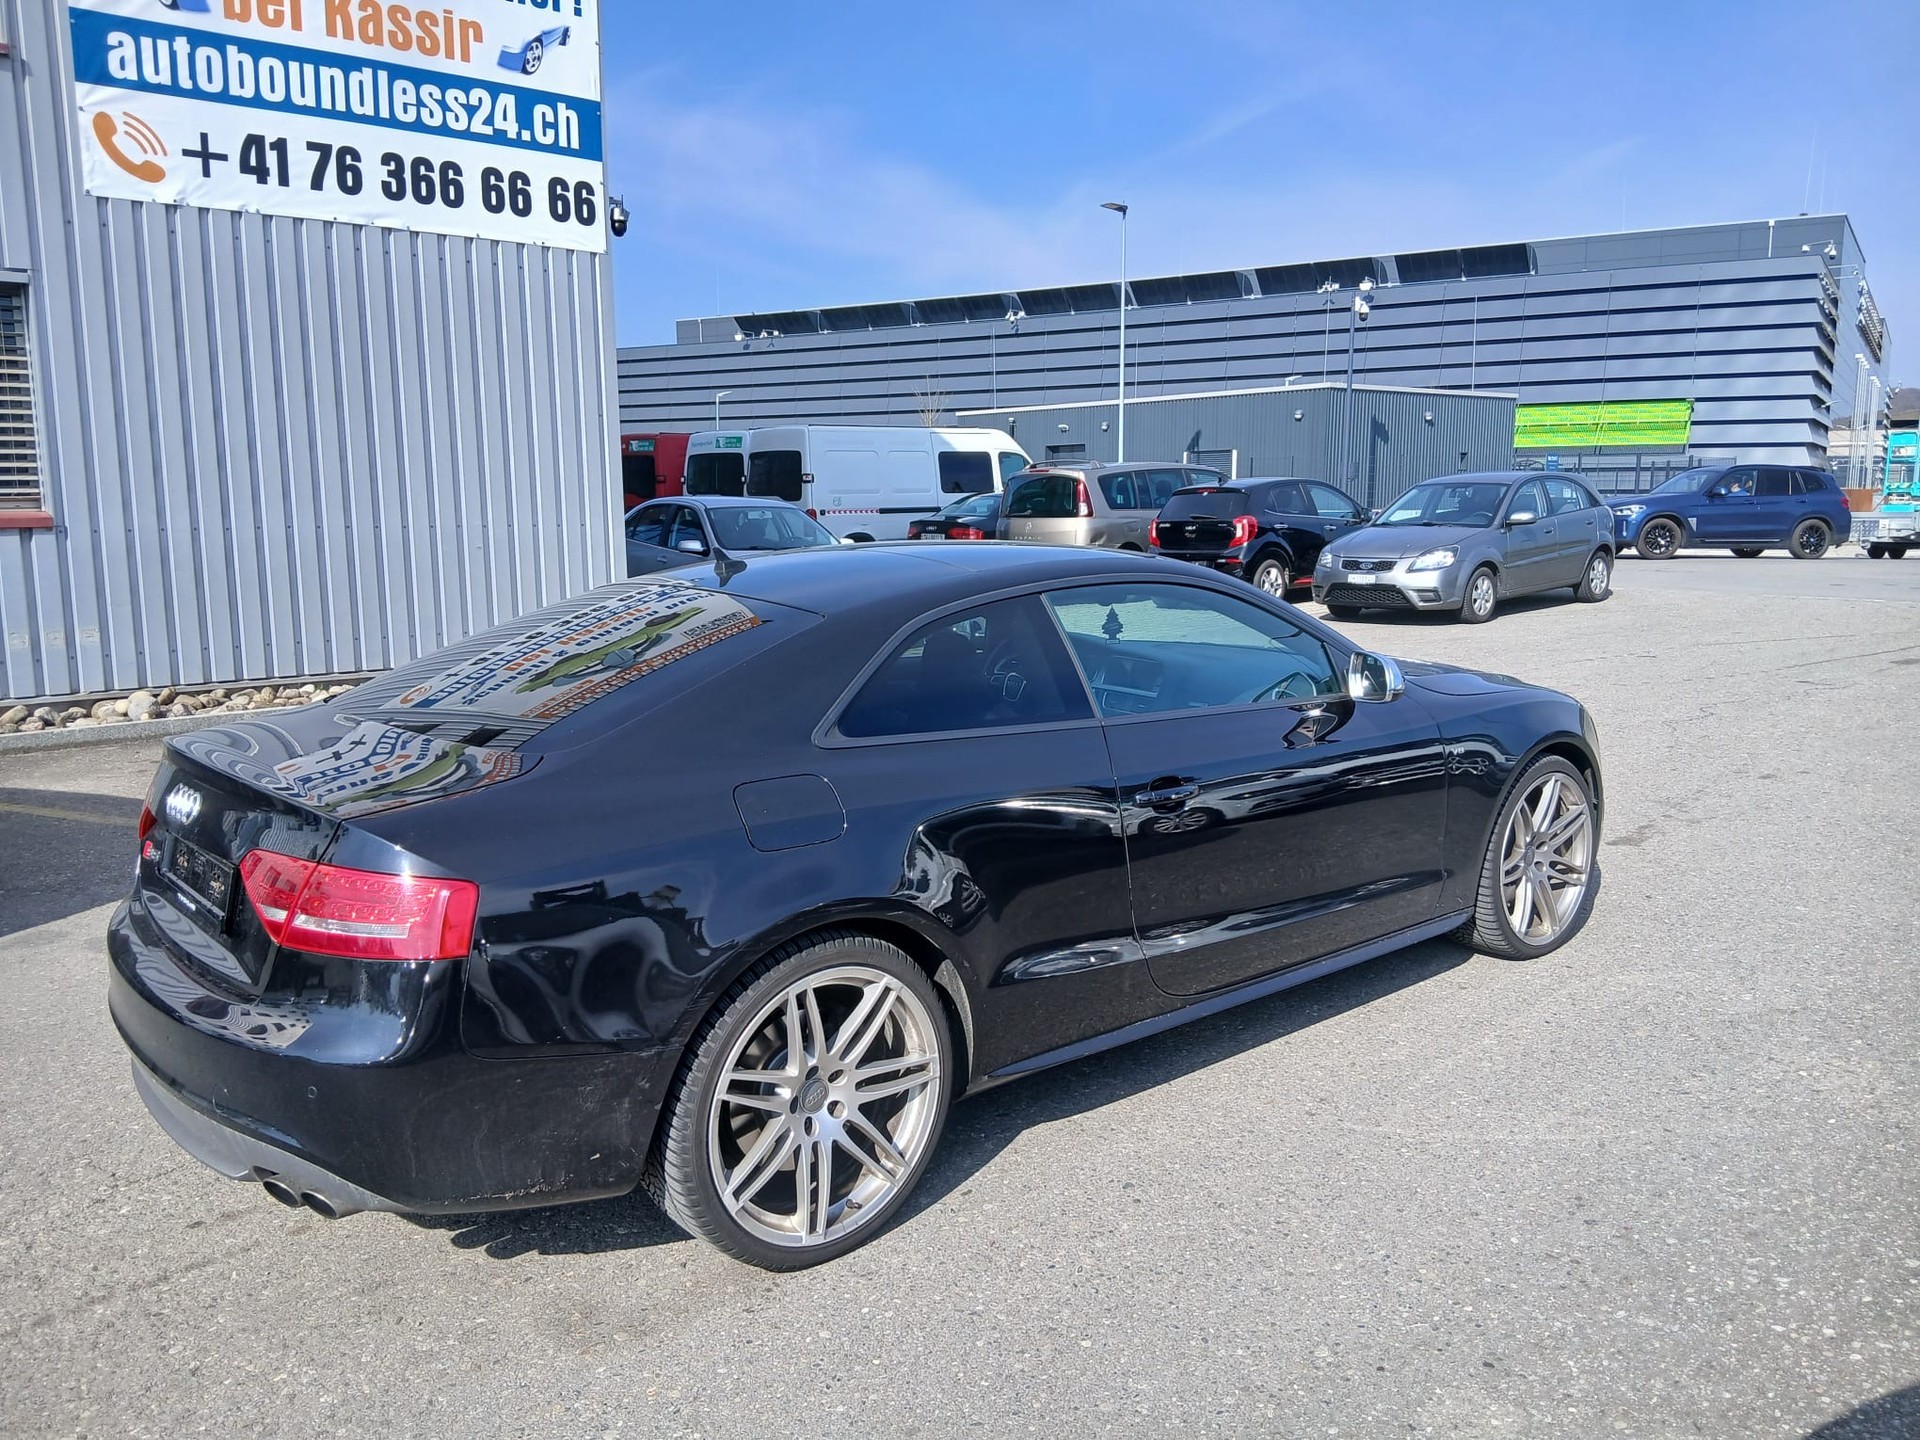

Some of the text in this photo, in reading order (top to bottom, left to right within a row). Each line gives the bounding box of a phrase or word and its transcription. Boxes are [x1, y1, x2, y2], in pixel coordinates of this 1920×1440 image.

[325, 0, 483, 63] Kassir
[107, 31, 580, 149] autoboundless24.ch
[182, 132, 597, 226] + 41 76 366 66 66
